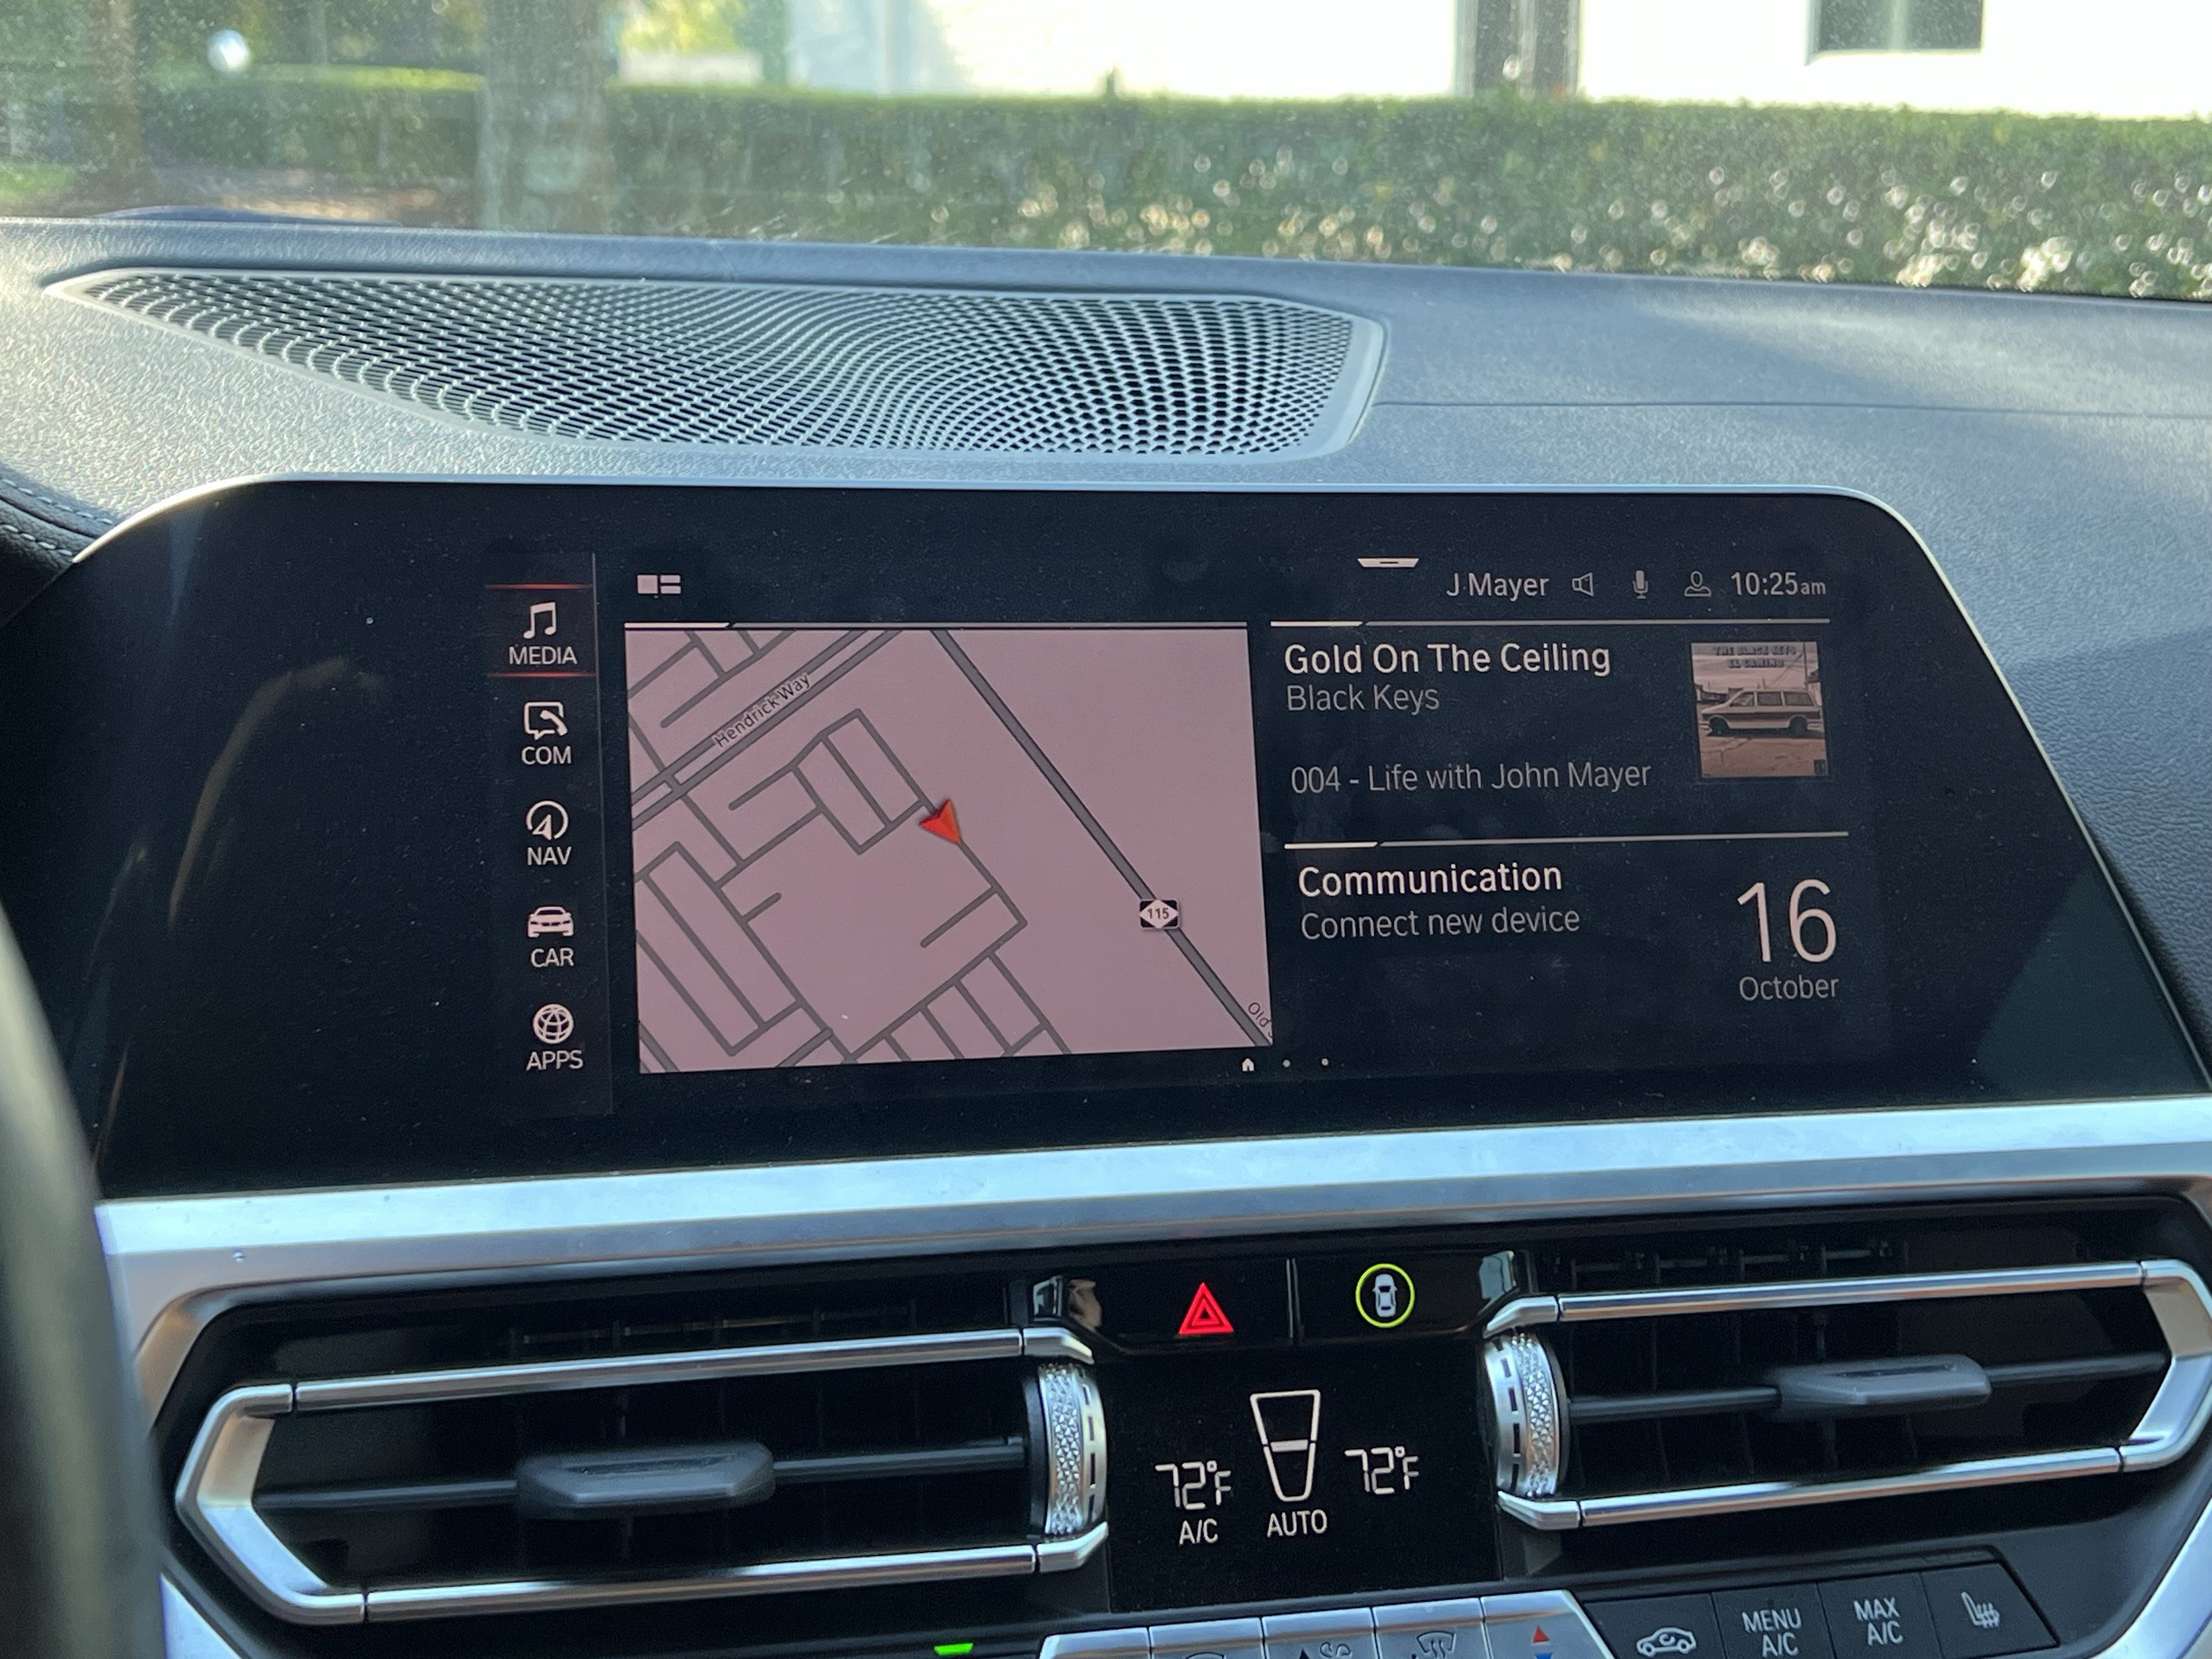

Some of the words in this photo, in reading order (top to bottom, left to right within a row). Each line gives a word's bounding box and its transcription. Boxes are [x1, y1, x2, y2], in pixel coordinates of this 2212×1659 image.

[1447, 573, 1459, 596] J
[1469, 573, 1549, 601] Mayer
[510, 646, 577, 664] MEDIA
[1285, 645, 1361, 674] Gold
[1374, 644, 1418, 673] On
[1427, 644, 1490, 672] The
[1501, 644, 1610, 676] Ceiling
[714, 696, 780, 747] Hendrick
[777, 675, 810, 700] Way
[1288, 684, 1364, 710] Black
[1374, 685, 1439, 715] Keys
[522, 746, 571, 764] COM
[1292, 766, 1340, 793] 004
[1369, 764, 1418, 791] Life
[1426, 764, 1481, 789] with
[1492, 763, 1558, 788] John
[1568, 762, 1651, 792] Mayer
[528, 847, 571, 865] NAV
[1299, 862, 1561, 896] Communication
[1147, 907, 1170, 920] 115
[1302, 911, 1419, 939] Connect
[1429, 914, 1482, 934] new
[1492, 906, 1579, 933] device
[1738, 879, 1836, 962] 16
[531, 948, 574, 967] CAR
[1740, 974, 1838, 1000] October
[527, 1050, 583, 1070] APPS
[1180, 1519, 1218, 1544] A/C
[1267, 1510, 1327, 1537] AUTO
[1742, 1608, 1801, 1633] MENU
[1853, 1596, 1900, 1621] MAX
[1762, 1632, 1798, 1657] A/C
[1867, 1620, 1903, 1645] A/C
